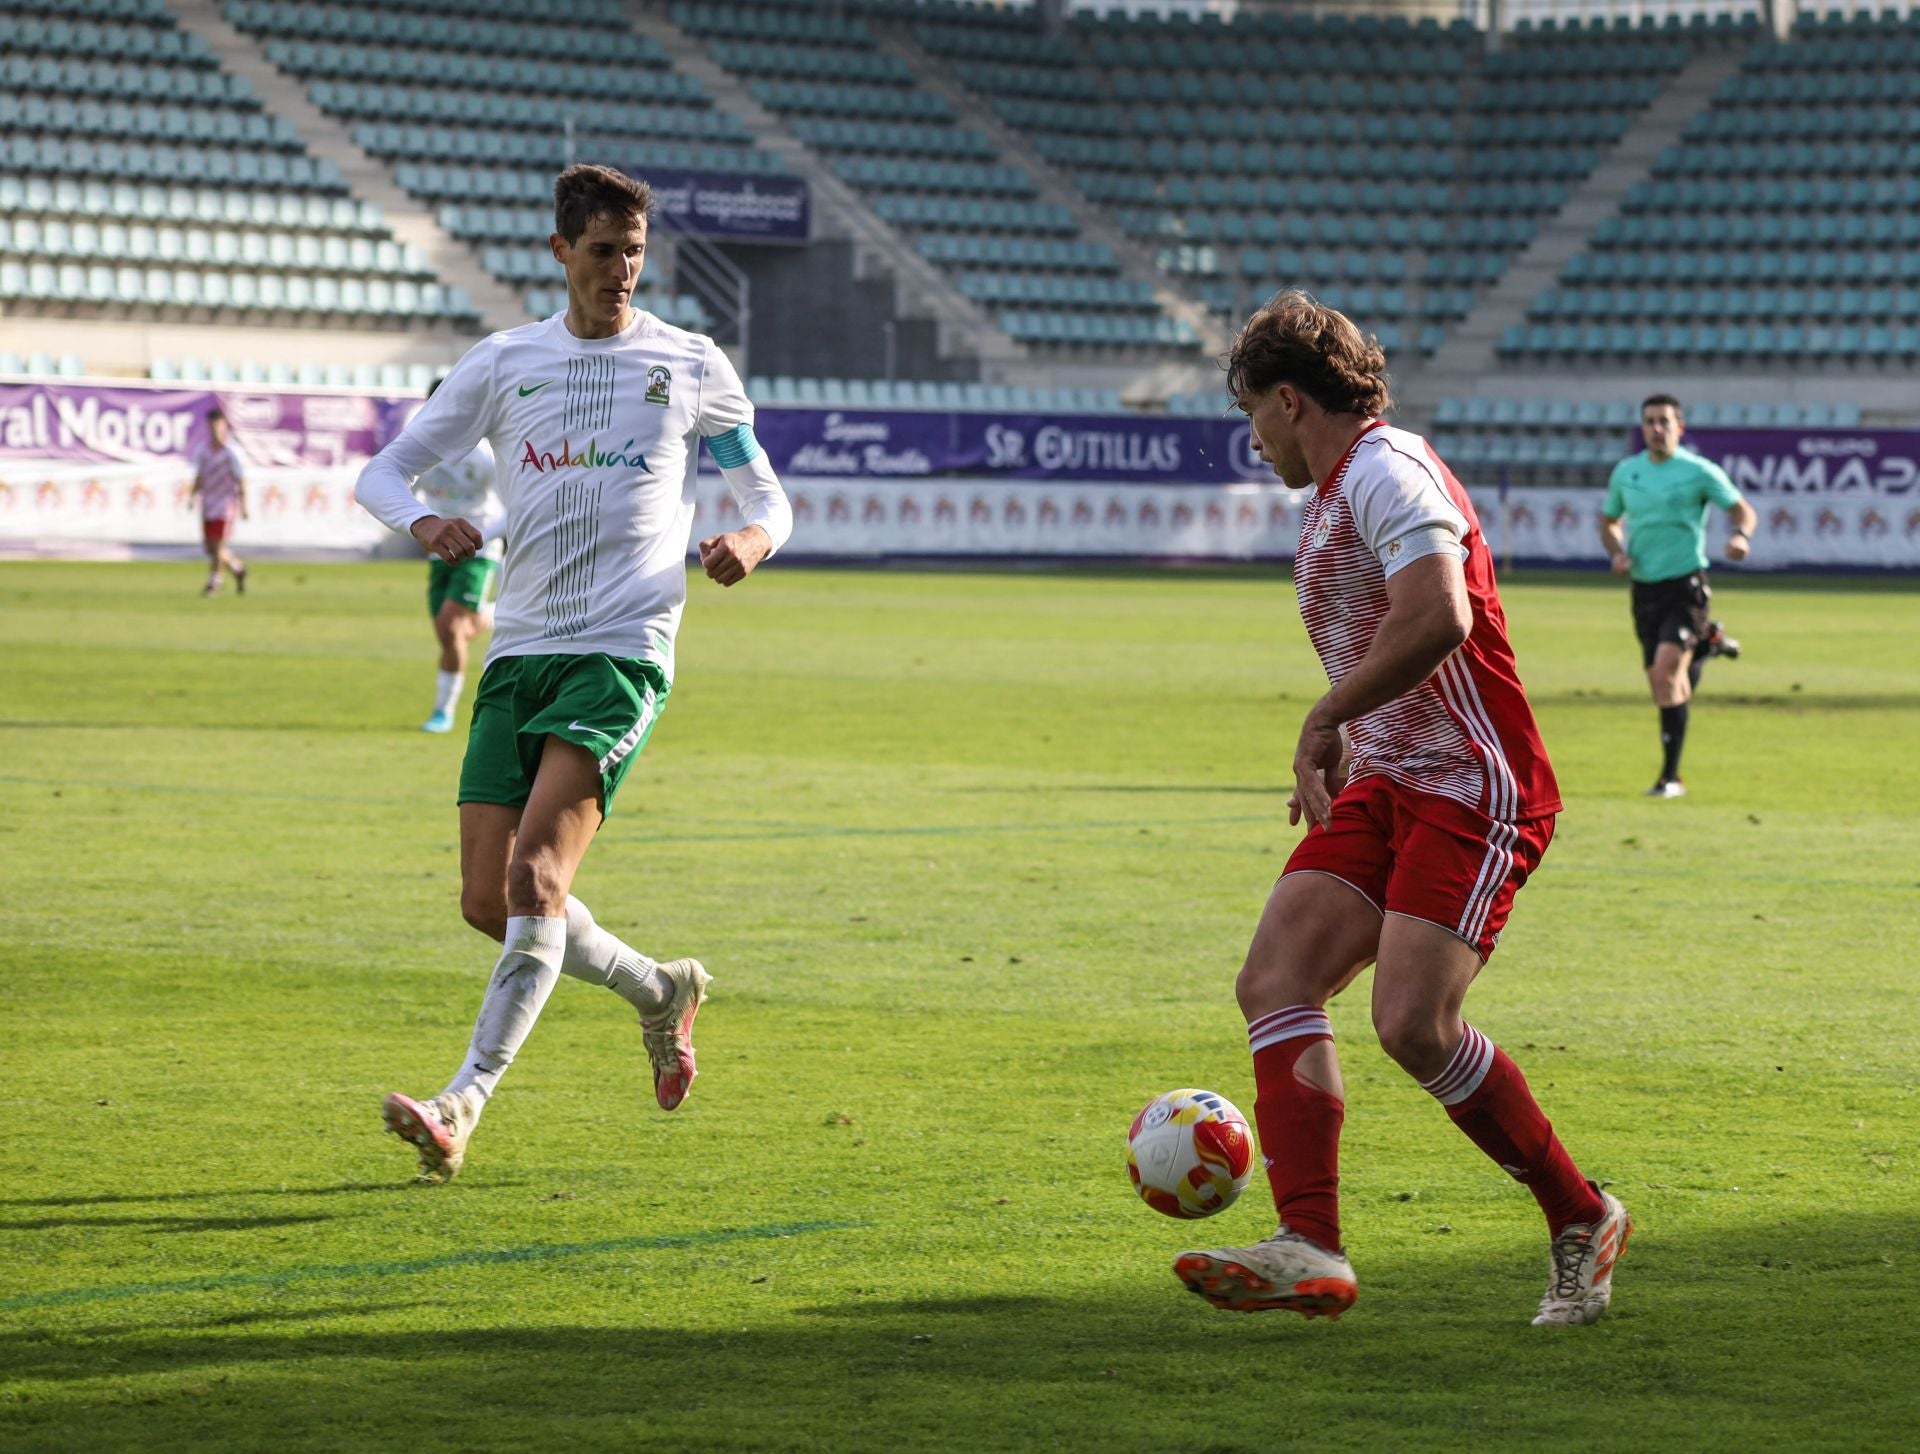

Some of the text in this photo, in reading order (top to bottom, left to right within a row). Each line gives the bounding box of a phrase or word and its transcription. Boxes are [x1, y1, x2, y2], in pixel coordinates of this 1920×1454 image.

[58, 396, 195, 454] Motor
[520, 437, 655, 475] Andalucía
[1722, 454, 1920, 496] INMAP
